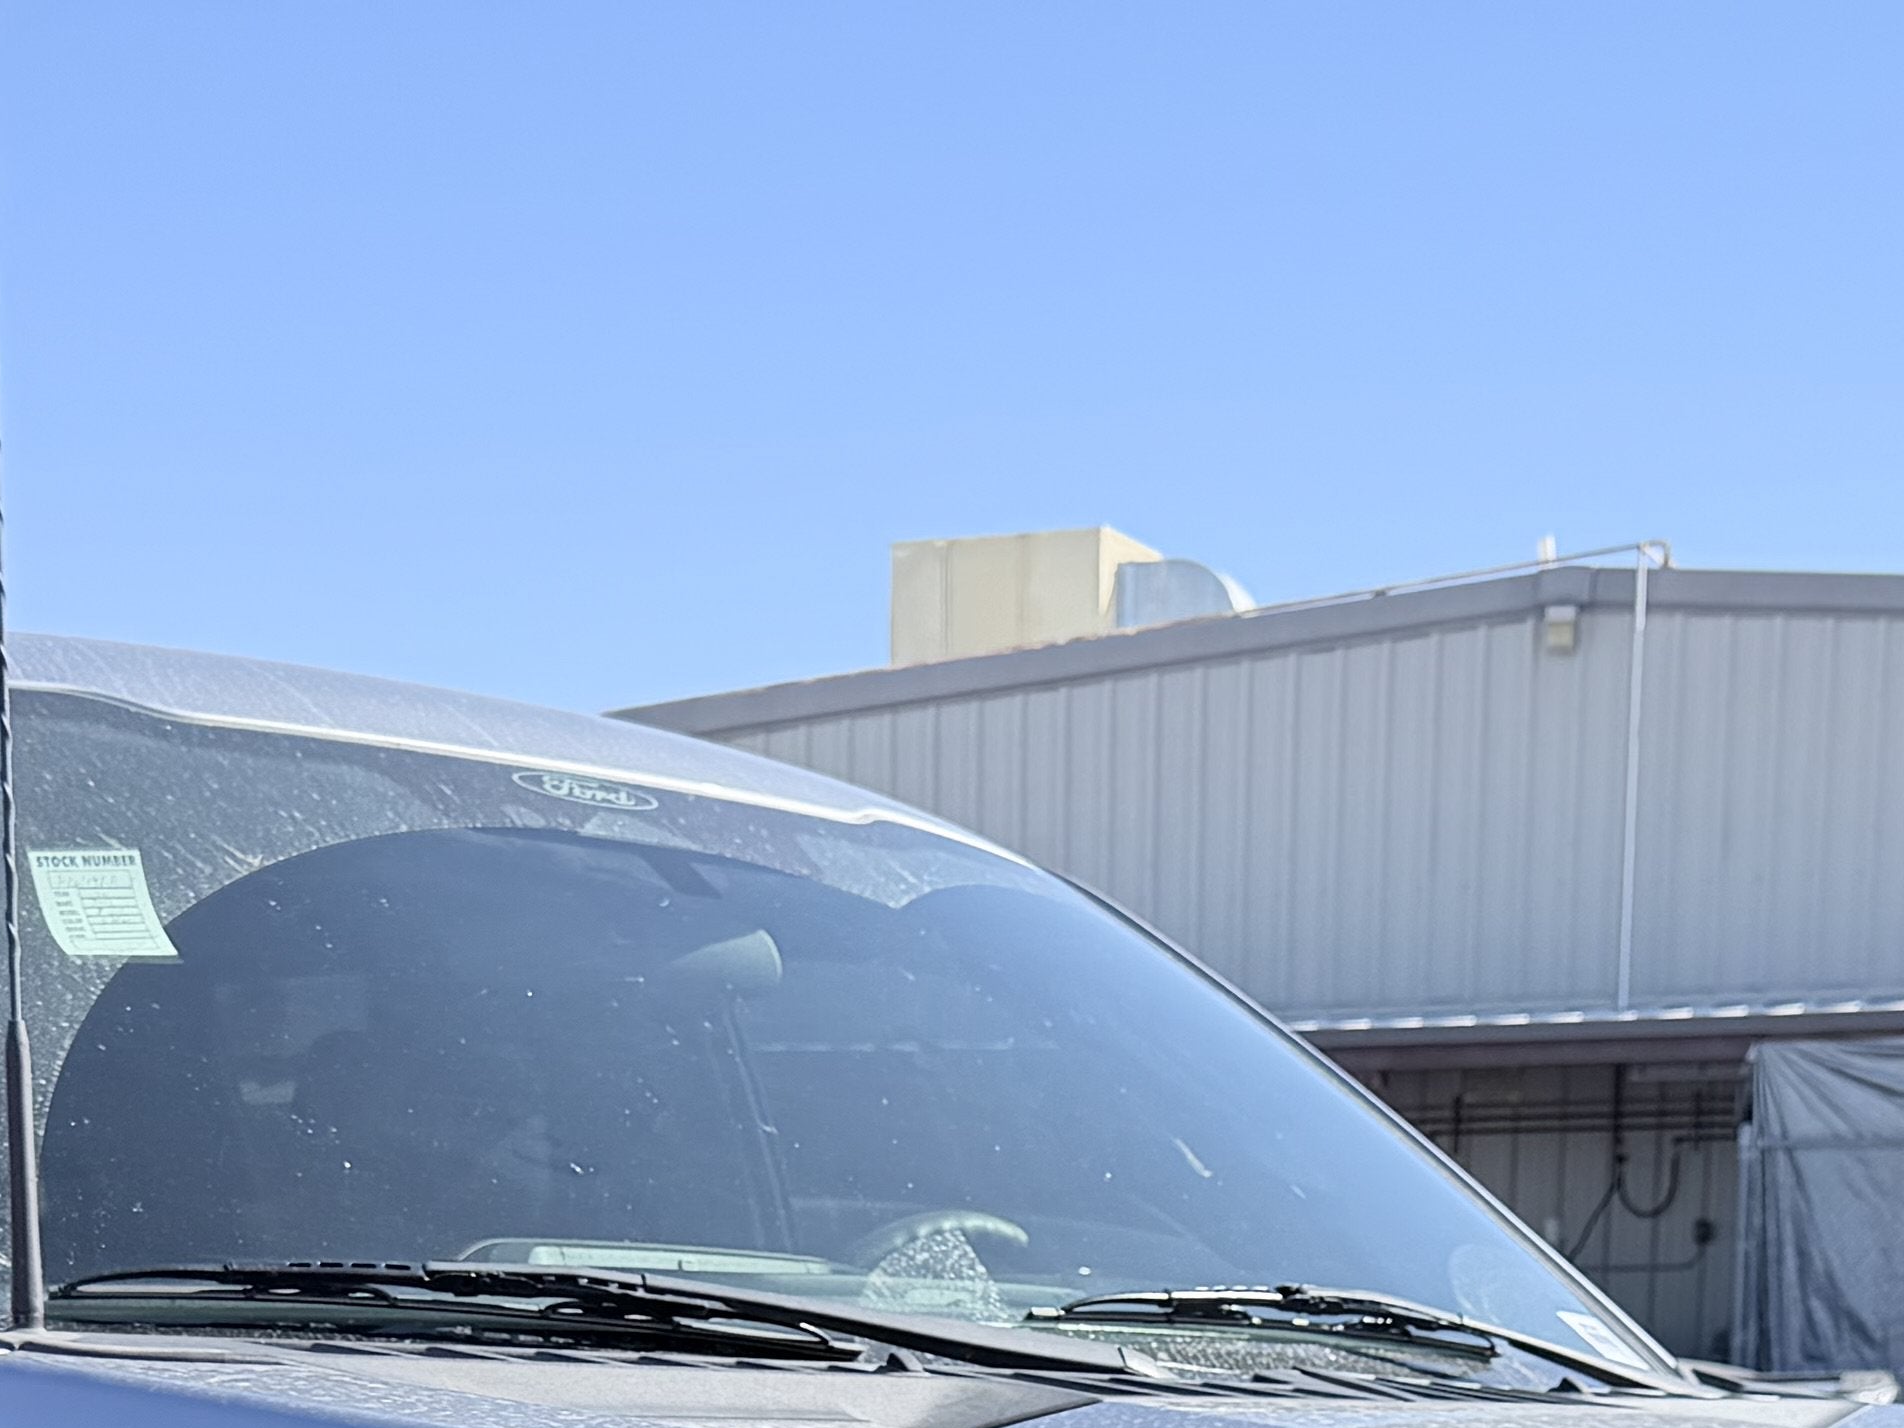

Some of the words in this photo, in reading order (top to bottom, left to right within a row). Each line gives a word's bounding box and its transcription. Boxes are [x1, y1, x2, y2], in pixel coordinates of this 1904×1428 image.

[542, 773, 637, 806] Ford
[36, 854, 79, 868] STOCK
[81, 854, 137, 868] NUMBER
